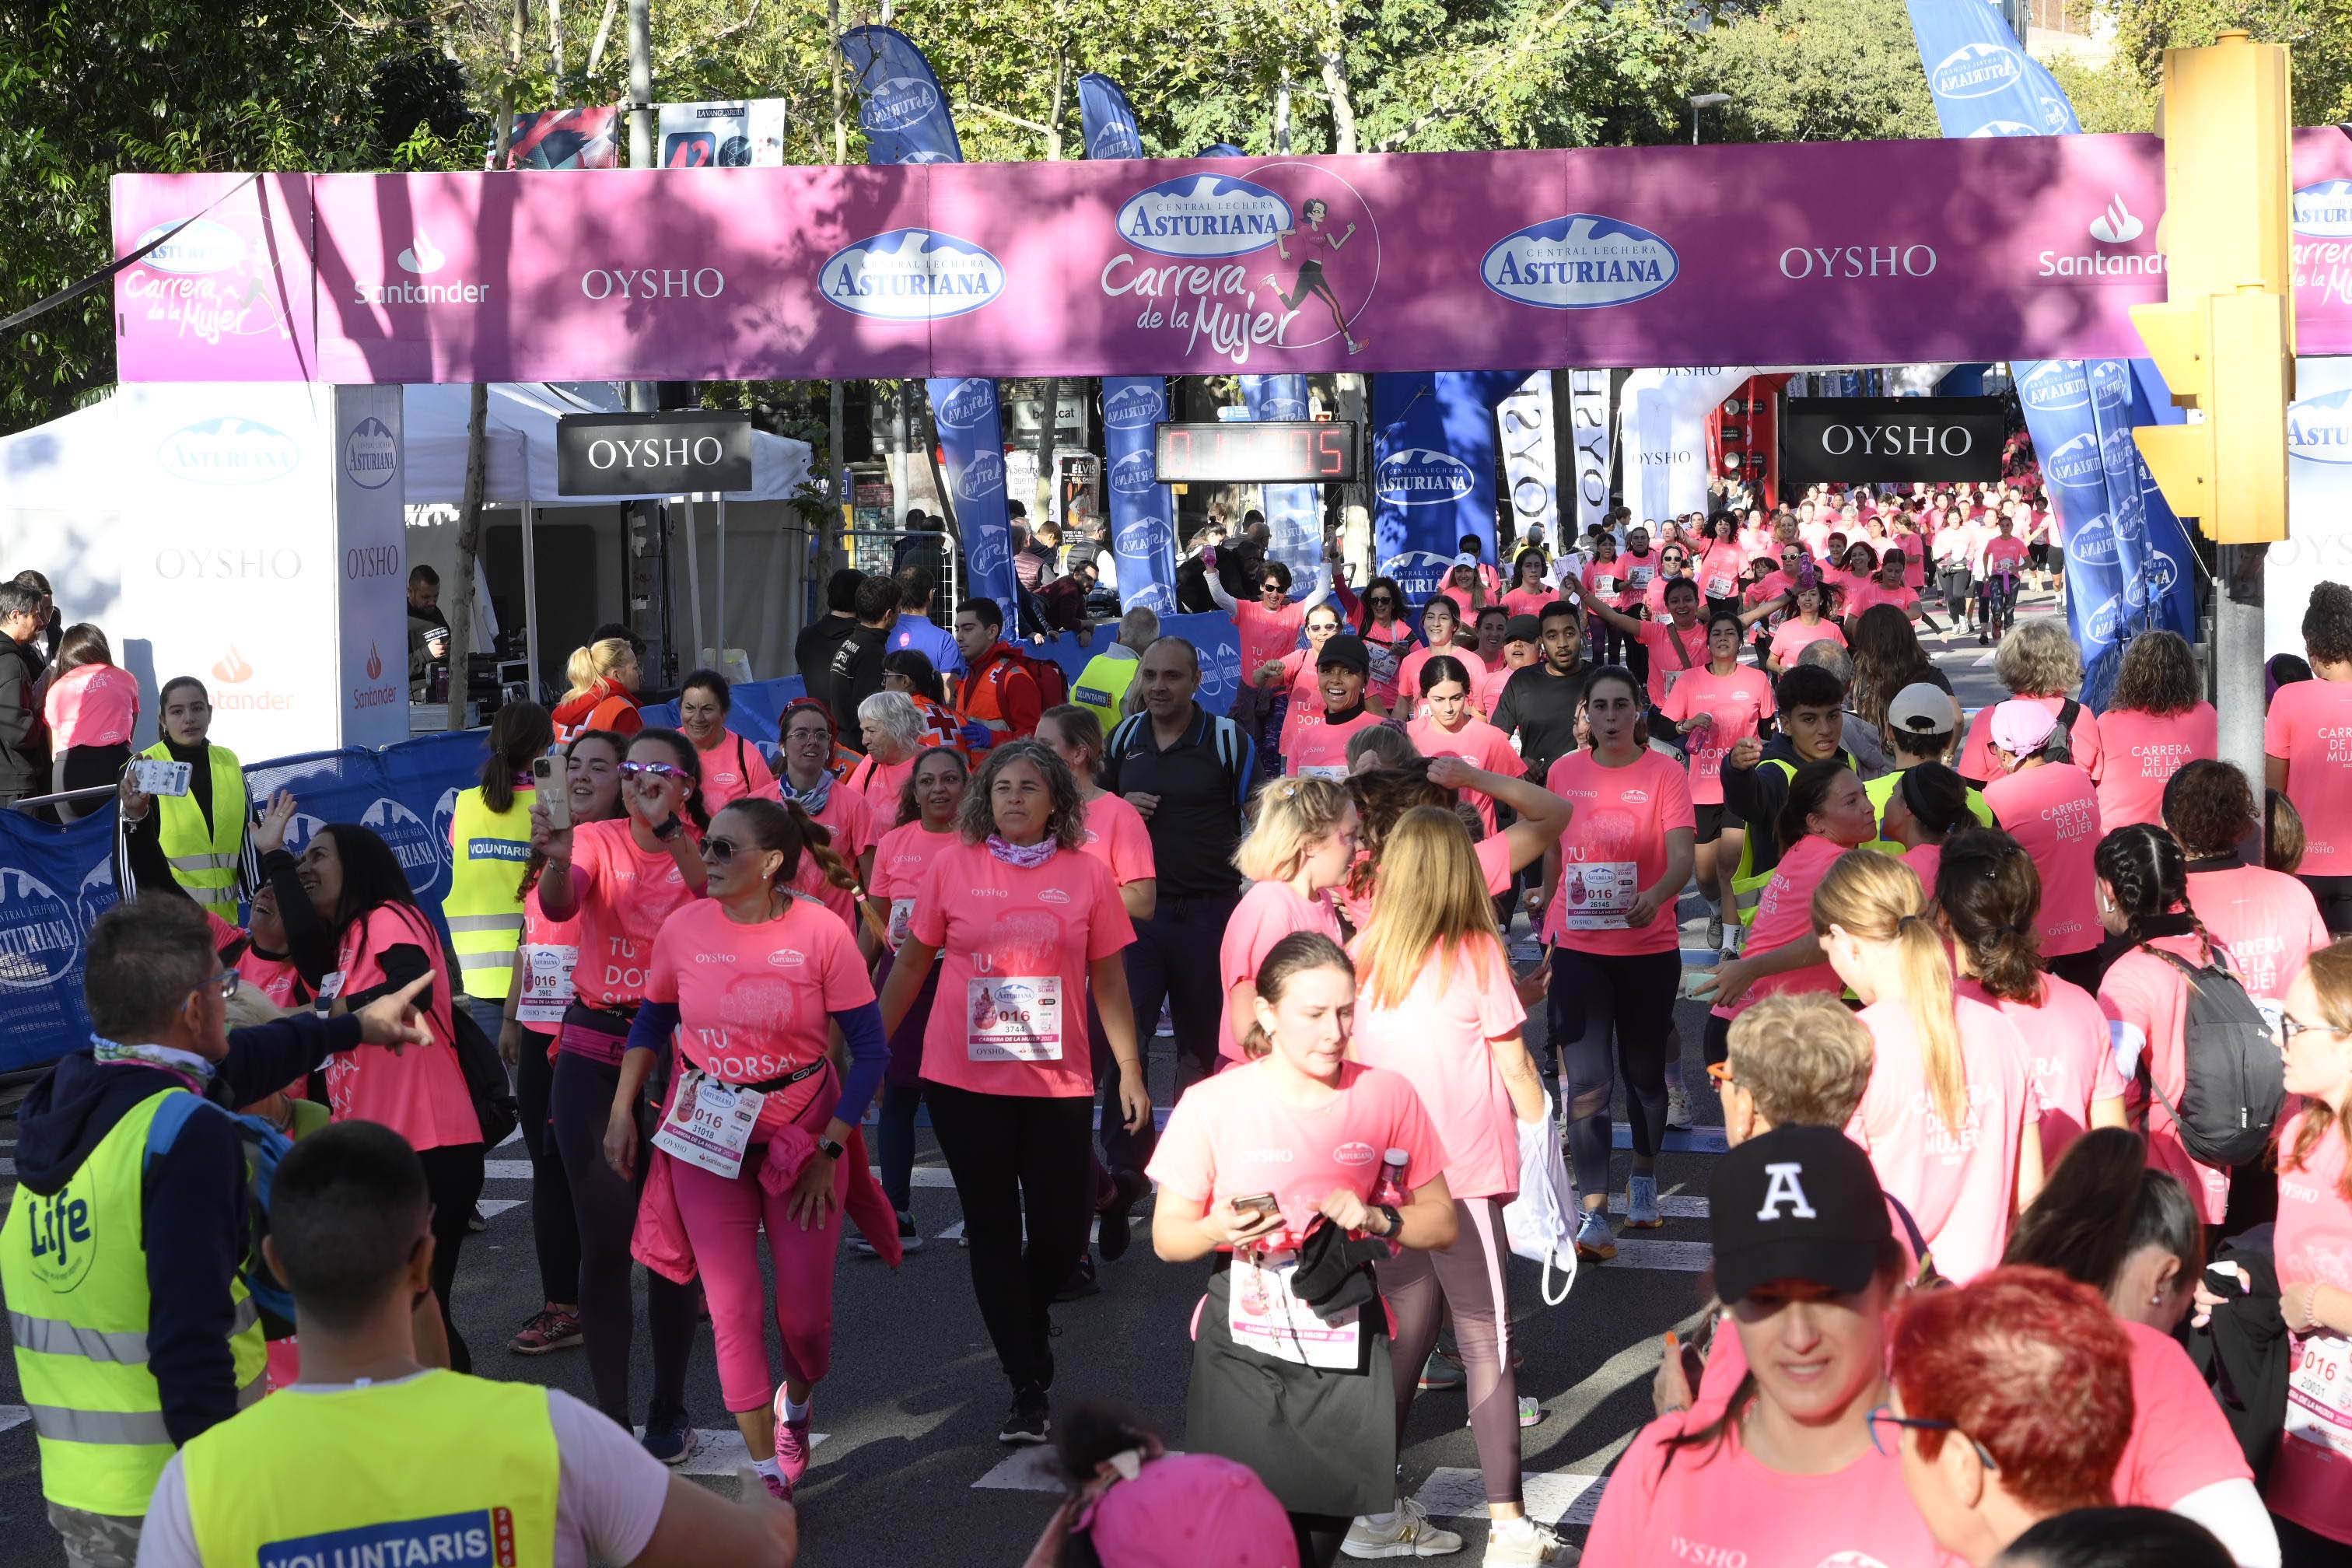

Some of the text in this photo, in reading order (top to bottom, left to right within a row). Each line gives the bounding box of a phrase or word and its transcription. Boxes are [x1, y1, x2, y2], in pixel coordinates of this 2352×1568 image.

[1157, 201, 1274, 212] CENTRAL LECHERA
[1130, 205, 1279, 237] ASTURIANA
[1527, 244, 1657, 257] CENTRAL LECHERA
[1496, 251, 1664, 286] ASTURIANA
[1780, 244, 1937, 279] OYSHO
[2039, 250, 2168, 277] Santand
[124, 270, 216, 300] Carrera
[582, 268, 725, 300] OYSHO
[832, 262, 991, 297] ASTURIANA
[1101, 254, 1247, 299] Carrera
[2312, 269, 2324, 286] la
[354, 280, 489, 305] Santander
[1136, 291, 1301, 365] de la Mujer
[1822, 425, 1972, 457] OYSHO
[348, 446, 394, 472] ASTURIANA
[588, 436, 723, 469] OYSHO
[1632, 450, 1692, 465] OYSHO
[1072, 464, 1096, 473] ELVIS
[1379, 472, 1467, 492] ASTURIANA
[156, 548, 302, 579] OYSHO
[347, 544, 398, 579] OYSHO
[1251, 646, 1262, 656] TU
[354, 684, 397, 710] Santander
[1297, 701, 1311, 711] TU
[2131, 744, 2193, 758] CARRERA
[2329, 739, 2345, 751] DE
[2143, 754, 2182, 766] DE LA
[1567, 789, 1598, 799] OYSHO
[2041, 798, 2095, 821] CARRERA
[2056, 810, 2090, 828] DE LA
[2056, 821, 2094, 842] MUJER
[470, 843, 531, 858] VOLUNTARIS
[971, 887, 1008, 898] OYSHO
[1588, 889, 1612, 898] 016
[28, 904, 60, 916] LECHERA
[2049, 922, 2082, 937] OYSHO
[609, 936, 635, 958] TU
[2228, 936, 2286, 960] ARRERA
[695, 953, 736, 964] OYSHO
[770, 954, 804, 964] ASTURIANA
[971, 953, 992, 973] TU
[2252, 956, 2275, 972] LA
[534, 975, 556, 986] 016
[998, 991, 1032, 999] ASTURIANA
[999, 1010, 1030, 1022] 016
[698, 1027, 728, 1049] TU
[976, 1047, 1005, 1055] OYSHO
[702, 1088, 732, 1107] ASTURIANA
[740, 1100, 756, 1110] SUMA
[695, 1108, 723, 1129] 016
[672, 1128, 691, 1143] CARRERA
[705, 1141, 722, 1154] MUJER
[692, 1125, 714, 1139] 31018
[663, 1137, 688, 1153] OYSHO
[706, 1156, 733, 1171] Santander
[1337, 1150, 1375, 1163] ASTURIANA
[1757, 1163, 1817, 1221] A
[29, 1187, 91, 1266] Life
[2305, 1351, 2336, 1381] 016
[266, 1528, 488, 1568] VOLUNTARIS
